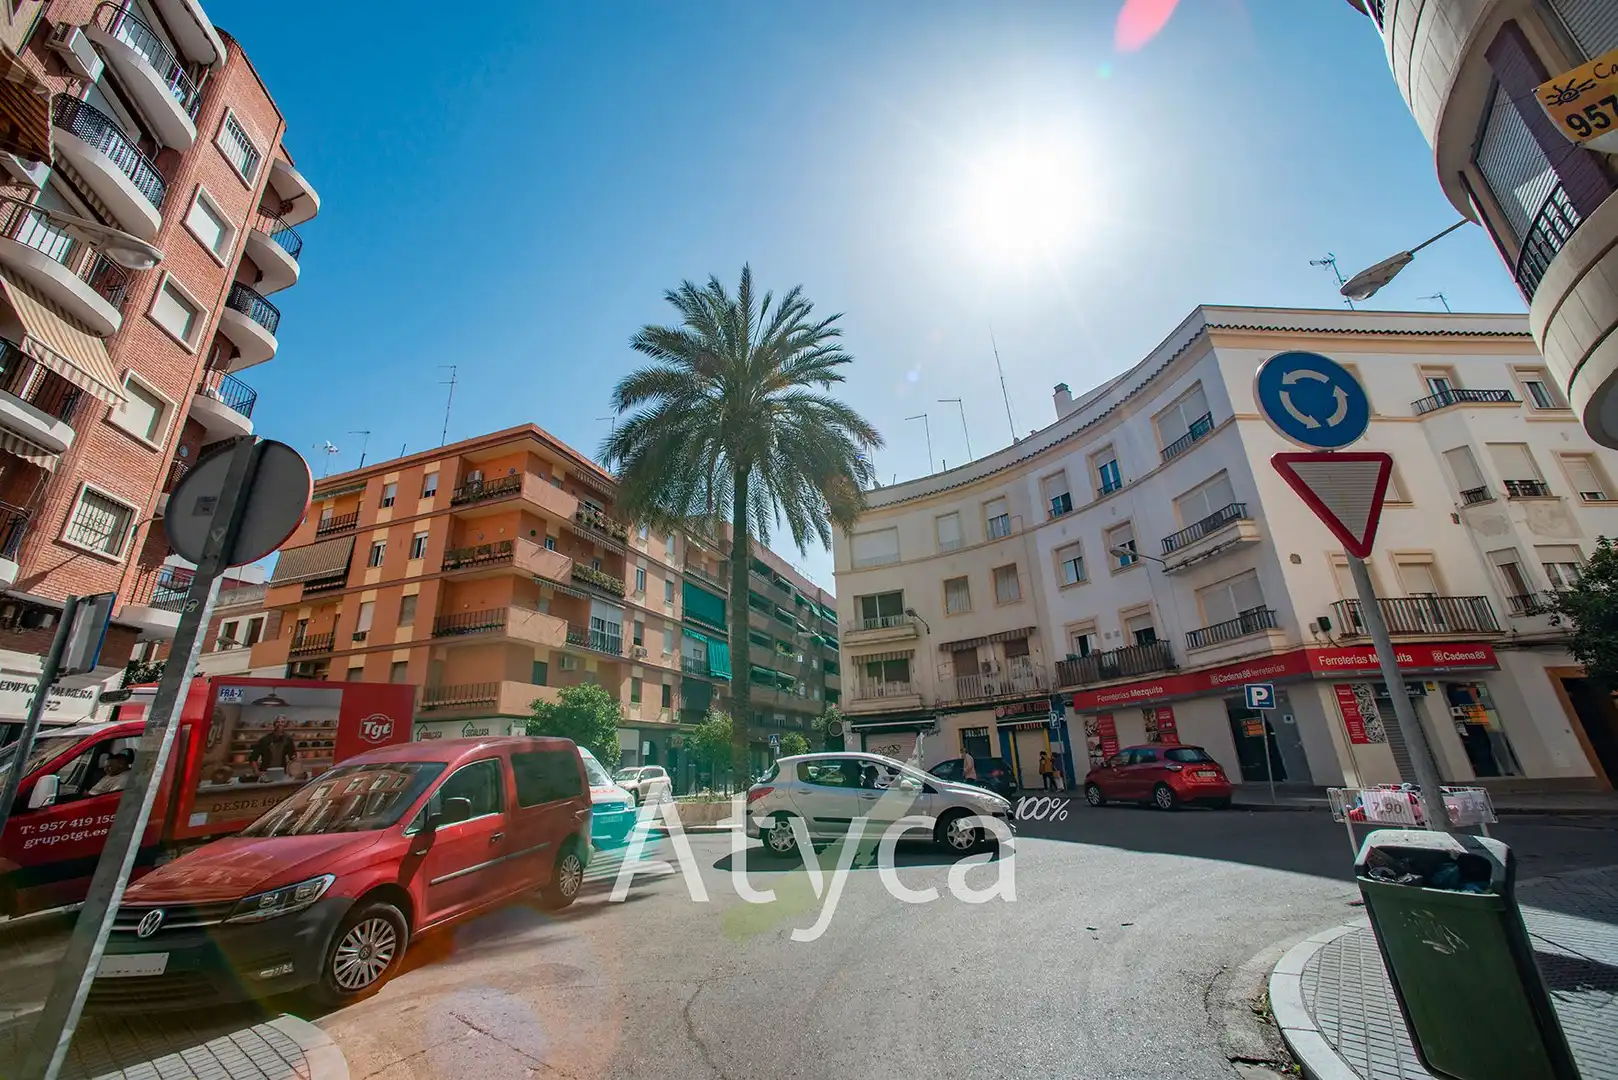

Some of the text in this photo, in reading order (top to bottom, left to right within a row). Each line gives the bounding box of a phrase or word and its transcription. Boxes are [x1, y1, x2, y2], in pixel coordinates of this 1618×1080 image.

[1566, 93, 1618, 138] 957
[1369, 652, 1413, 664] Muita
[0, 680, 39, 694] EDIFICI
[220, 687, 244, 698] FRA-X
[1130, 685, 1164, 698] Mezquita
[1251, 687, 1269, 706] P
[25, 697, 61, 712] 12
[363, 721, 391, 740] Tgt
[212, 798, 258, 813] DESDE
[39, 820, 68, 833] 957
[69, 816, 93, 828] 419
[23, 827, 109, 850] grupotgt.es
